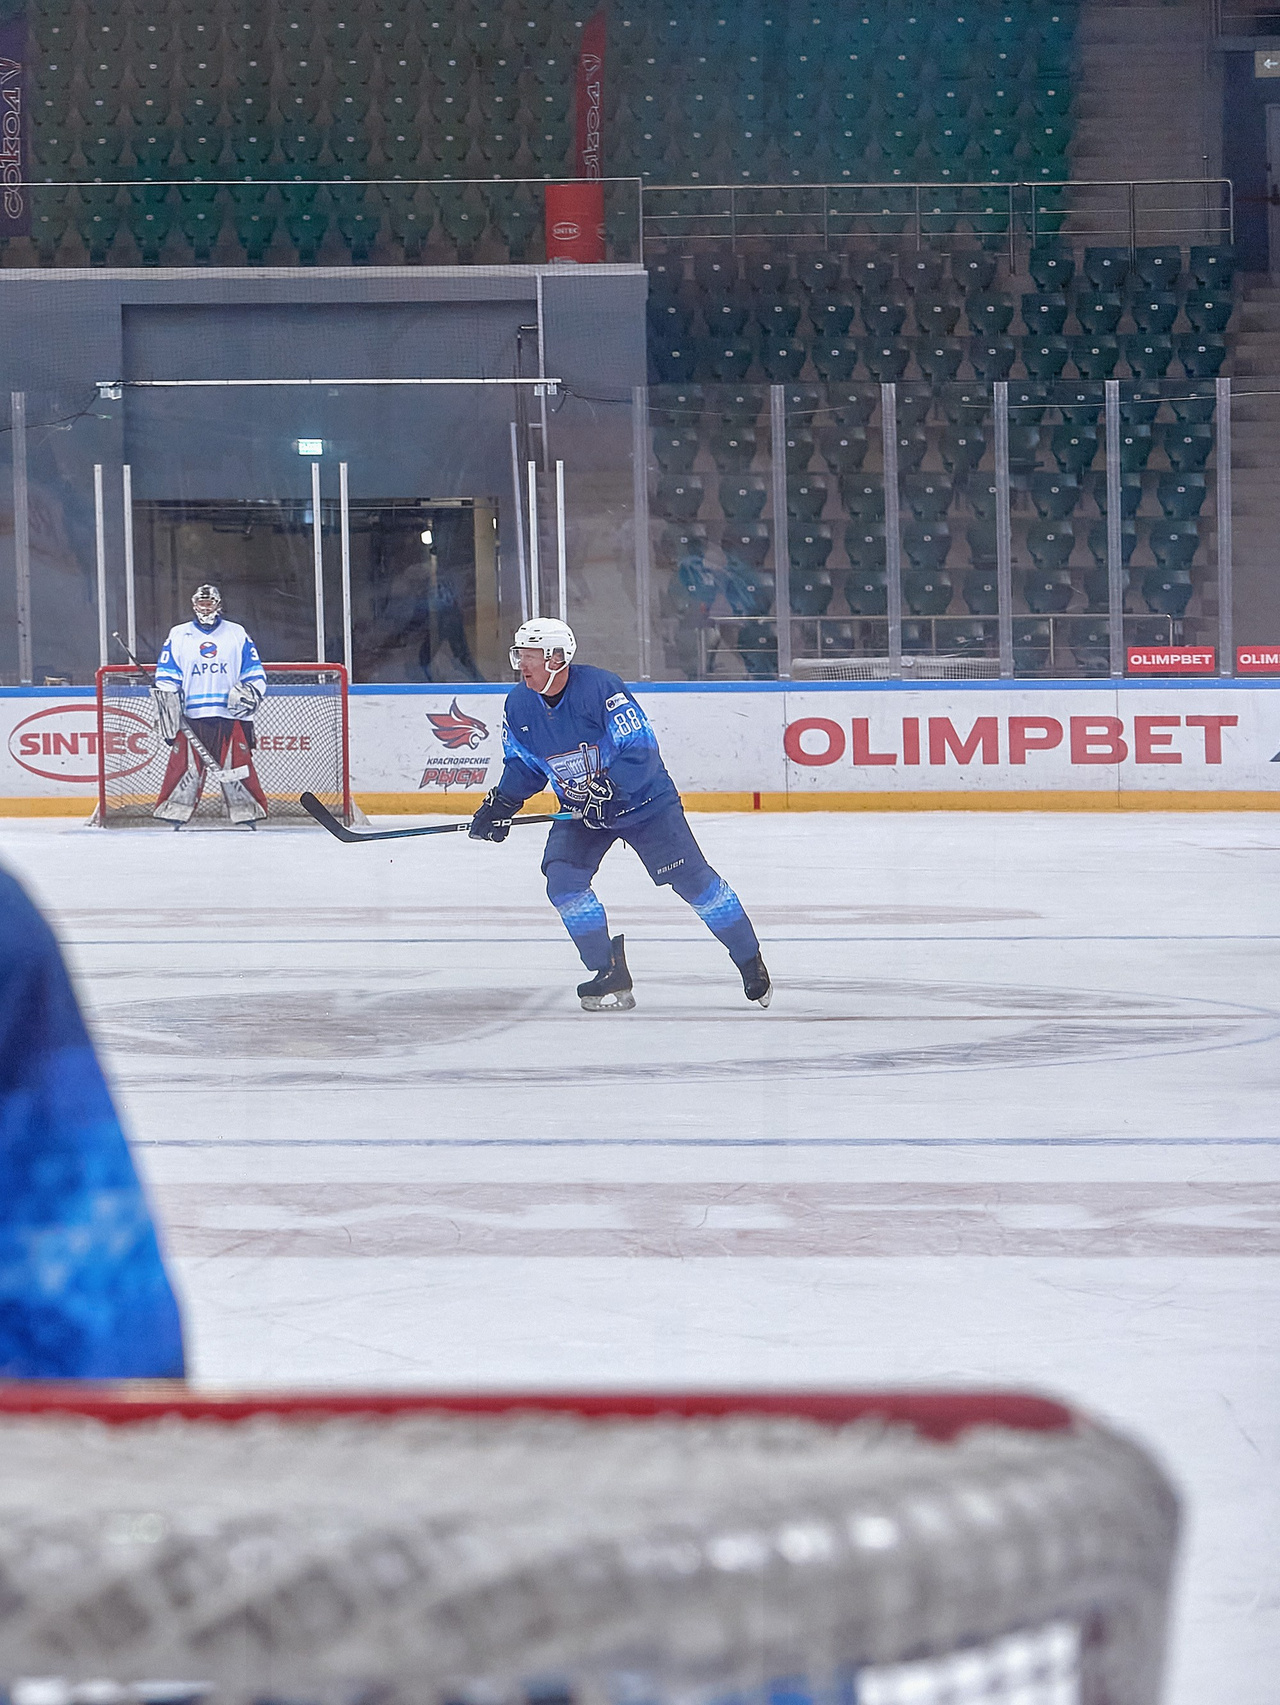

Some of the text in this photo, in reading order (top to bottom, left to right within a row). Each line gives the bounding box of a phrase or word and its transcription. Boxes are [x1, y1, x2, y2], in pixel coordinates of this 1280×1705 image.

[1130, 654, 1212, 665] OLIMPBET
[1239, 653, 1280, 664] OLIM
[191, 663, 228, 676] ДРСК
[614, 707, 642, 735] 88
[20, 732, 149, 756] SINTEC
[256, 736, 311, 751] EEZE
[783, 715, 1239, 766] OLIMPBET
[420, 767, 488, 789] РЫСИ
